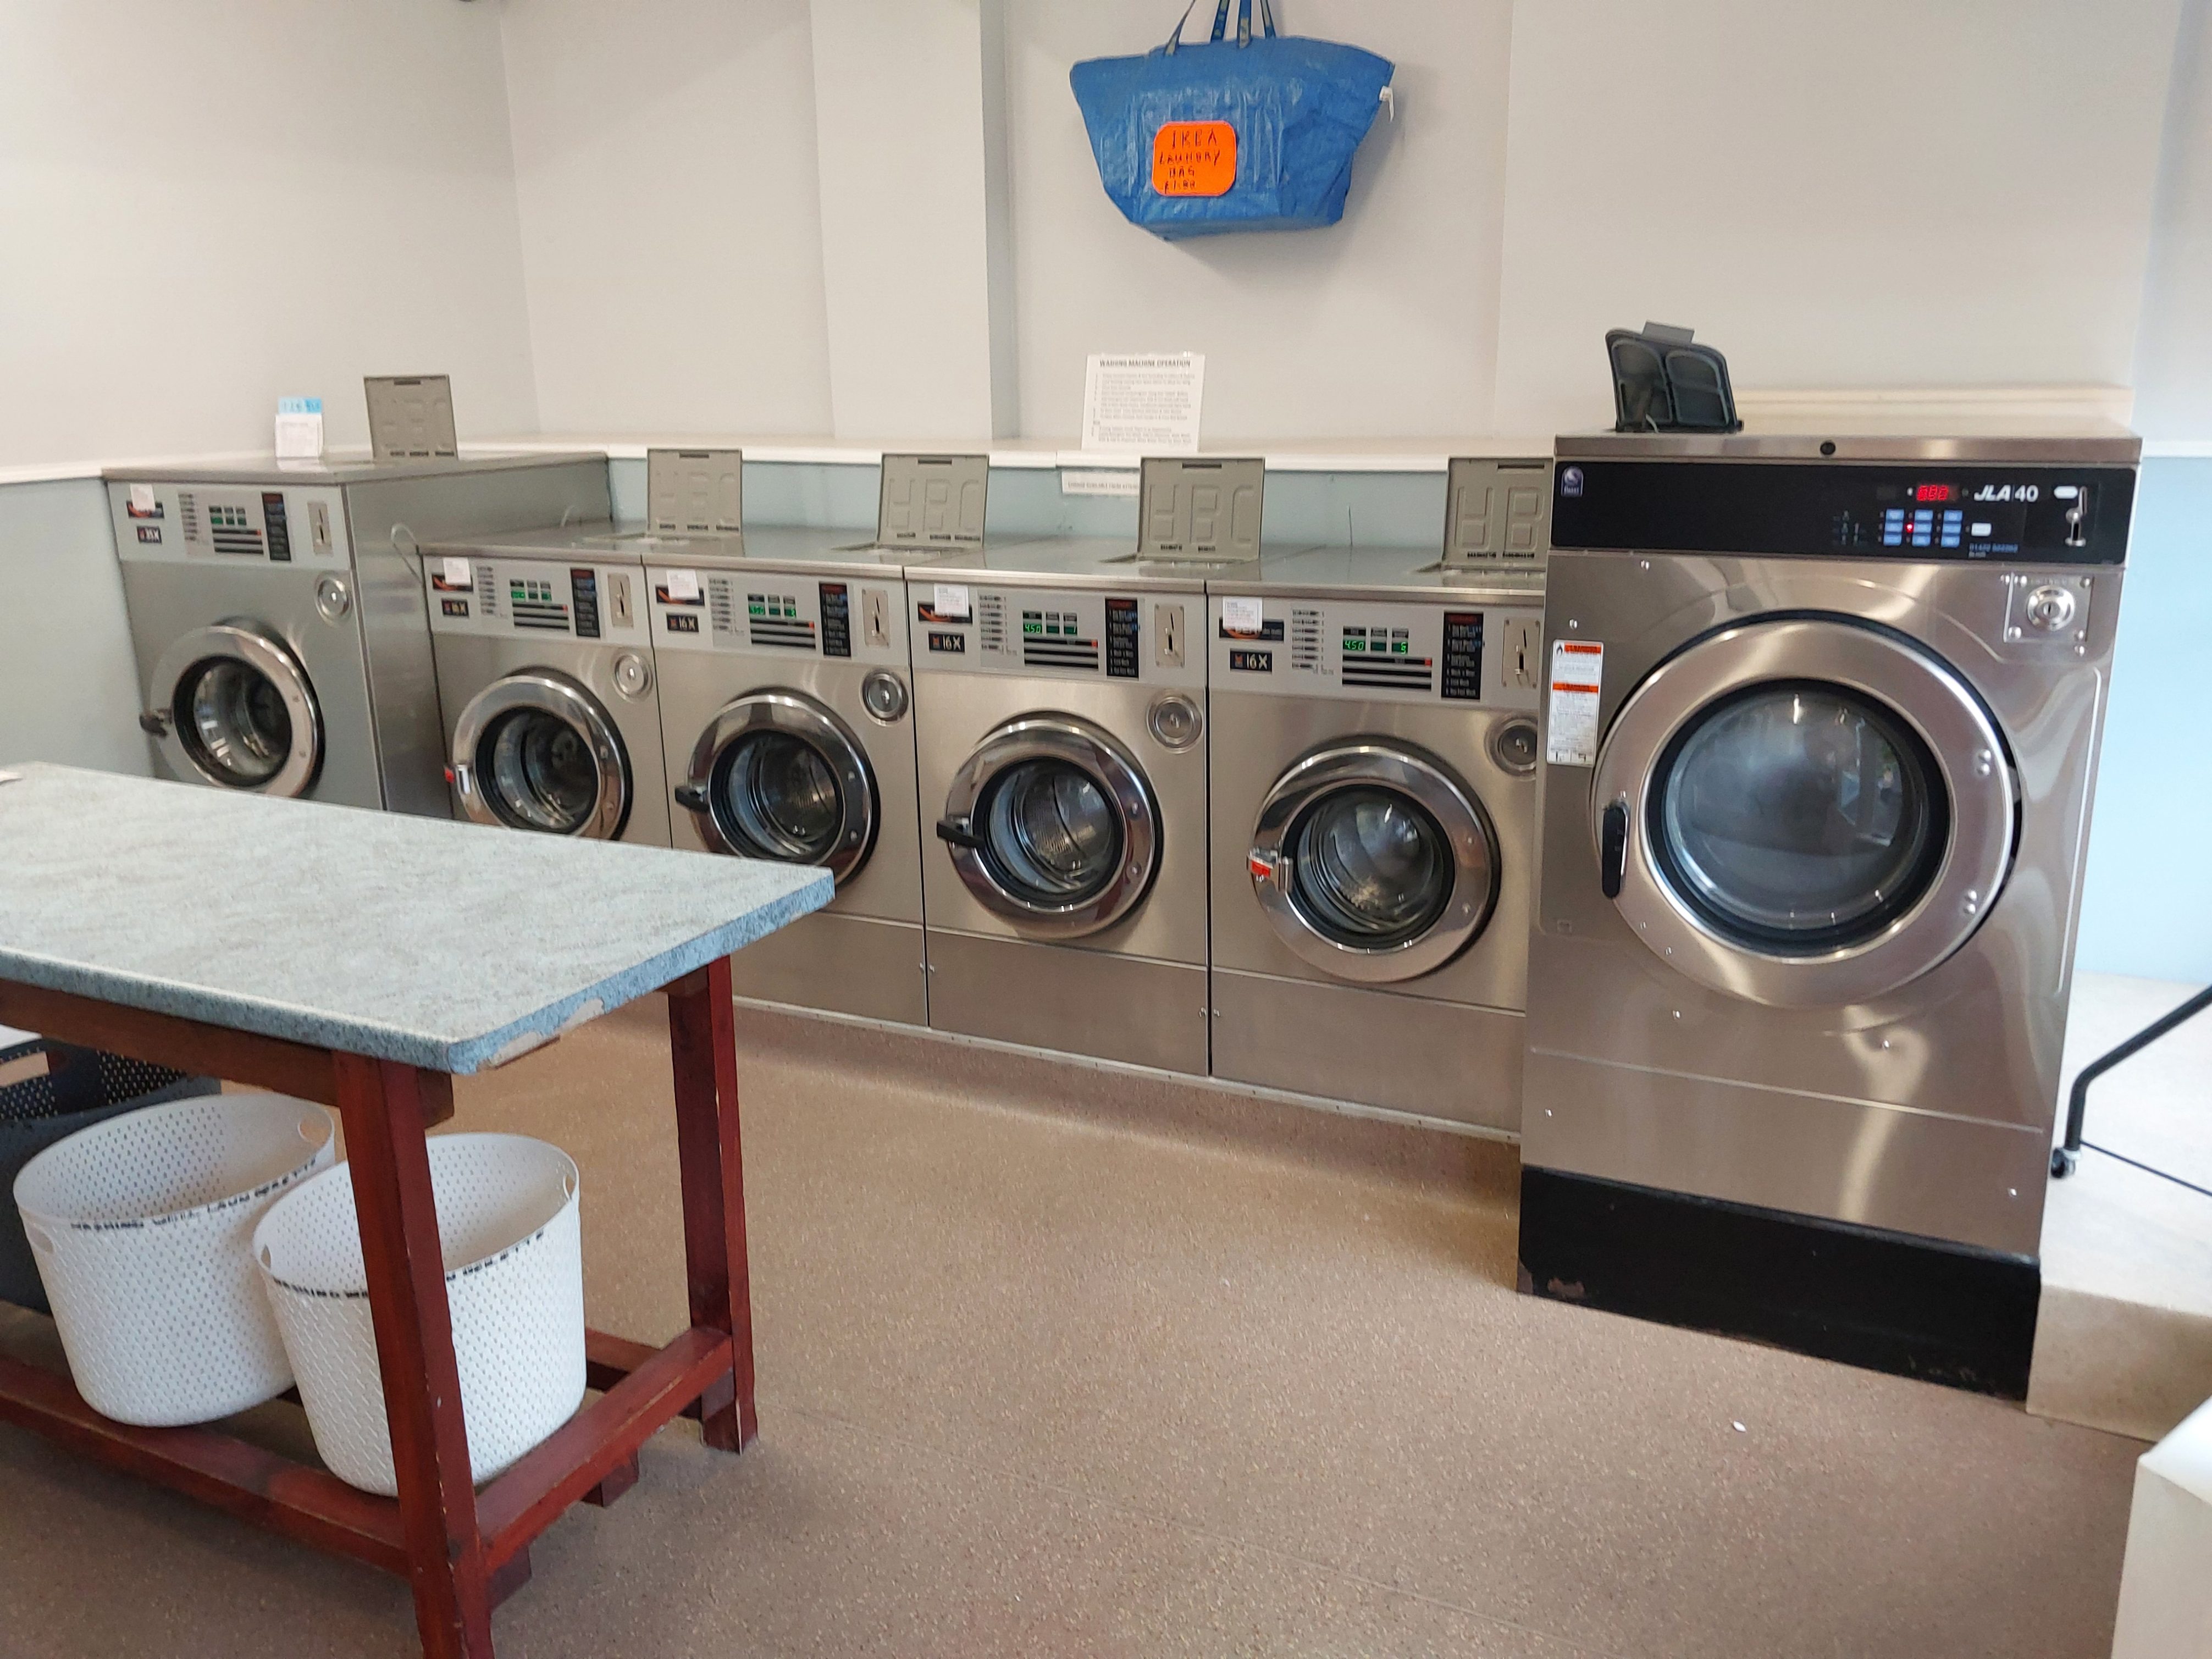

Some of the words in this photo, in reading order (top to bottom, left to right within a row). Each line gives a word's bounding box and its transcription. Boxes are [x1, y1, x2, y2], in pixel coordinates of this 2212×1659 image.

[1172, 128, 1217, 149] IKEA
[1159, 150, 1220, 166] LAUNDRY
[1169, 165, 1195, 178] BAG
[1973, 484, 2011, 502] JLA
[2014, 484, 2039, 502] 40
[1025, 624, 1041, 633] 450
[943, 634, 961, 650] 16X
[1345, 640, 1364, 650] 450
[1247, 653, 1268, 669] 16X
